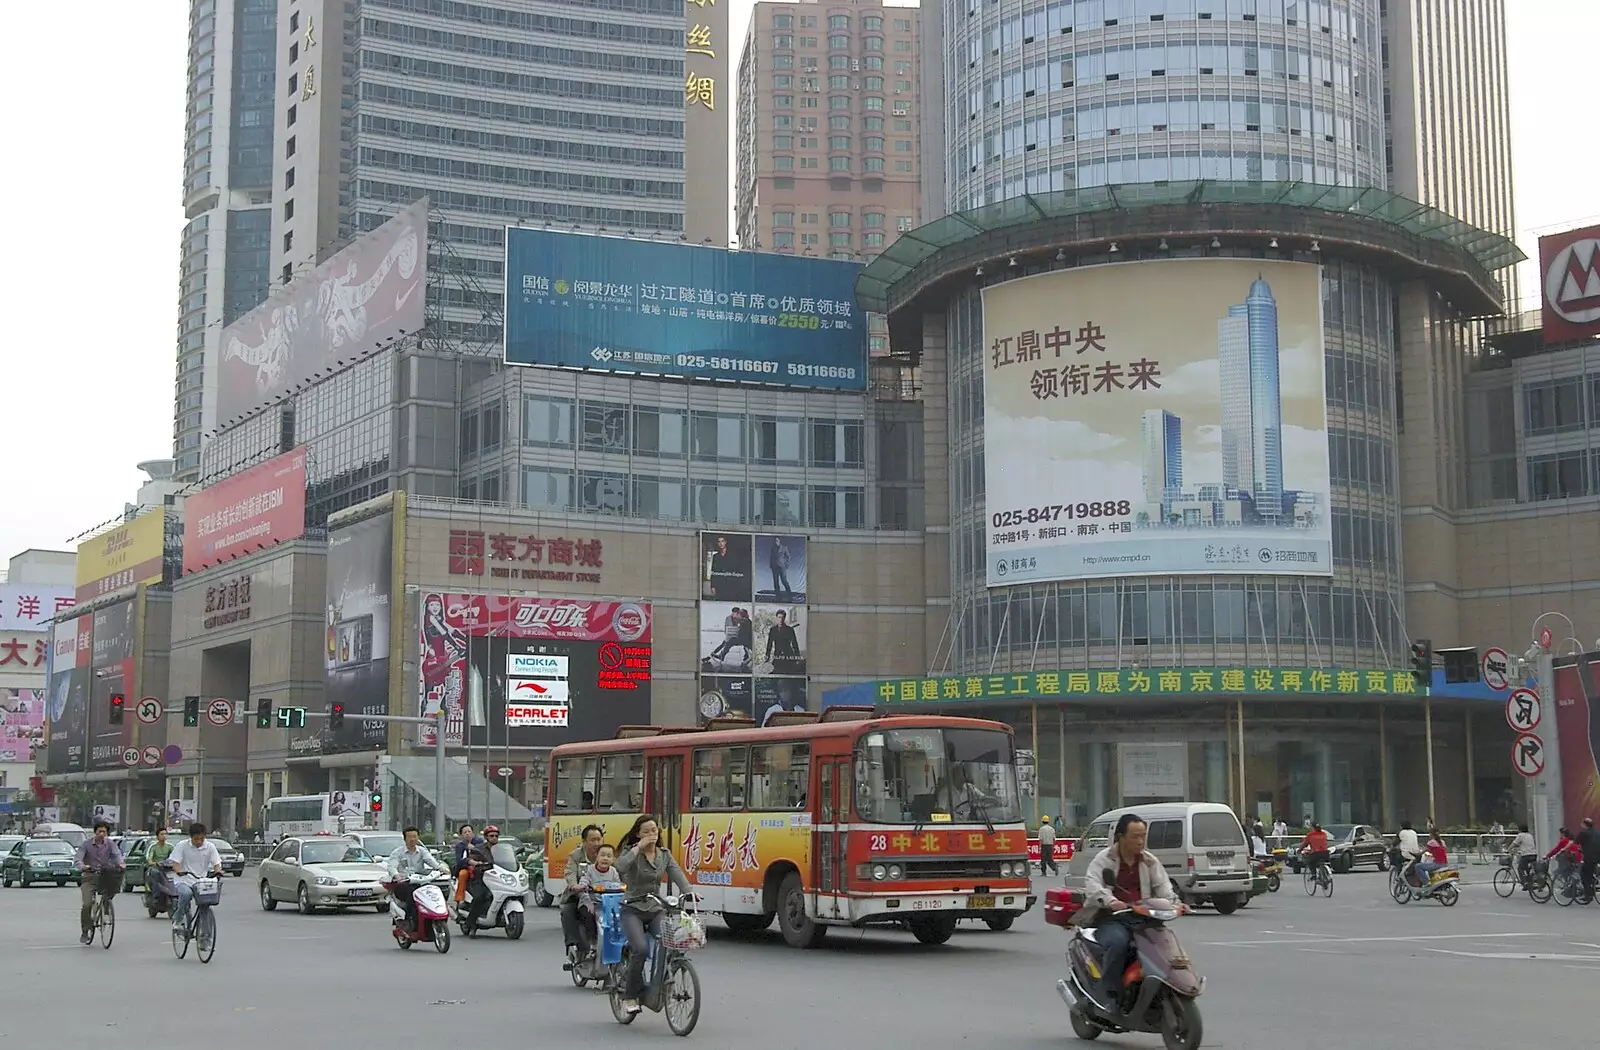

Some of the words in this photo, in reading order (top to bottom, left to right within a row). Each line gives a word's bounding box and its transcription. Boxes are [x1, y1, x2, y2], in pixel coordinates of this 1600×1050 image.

[302, 15, 317, 102] 大厦
[685, 0, 716, 111] 丝绸
[522, 274, 550, 290] 国信
[641, 283, 714, 306] 过江隧道
[730, 292, 766, 310] 首席
[780, 296, 852, 317] 优质领域
[778, 313, 819, 330] 2550
[991, 320, 1106, 370] 扛鼎中央
[677, 354, 779, 374] 025-58116667
[787, 364, 855, 379] 58116668
[1030, 358, 1162, 400] 领衔未来
[992, 500, 1131, 528] 025-84719888
[992, 530, 1030, 544] 汉中路1号
[1038, 527, 1067, 539] 新街口
[1077, 524, 1098, 536] 南京
[1108, 521, 1132, 533] 中国
[488, 532, 603, 568] 东方商城
[576, 573, 601, 583] STORE
[515, 604, 592, 630] 可口可乐
[515, 658, 558, 666] NOKIA
[880, 669, 1416, 702] 中国建筑第三工程局愿为南京建设再作新贡献
[278, 708, 304, 727] 47
[506, 708, 568, 718] SCARLET
[125, 752, 138, 760] 60
[871, 835, 887, 850] 28
[924, 900, 942, 909] 1120
